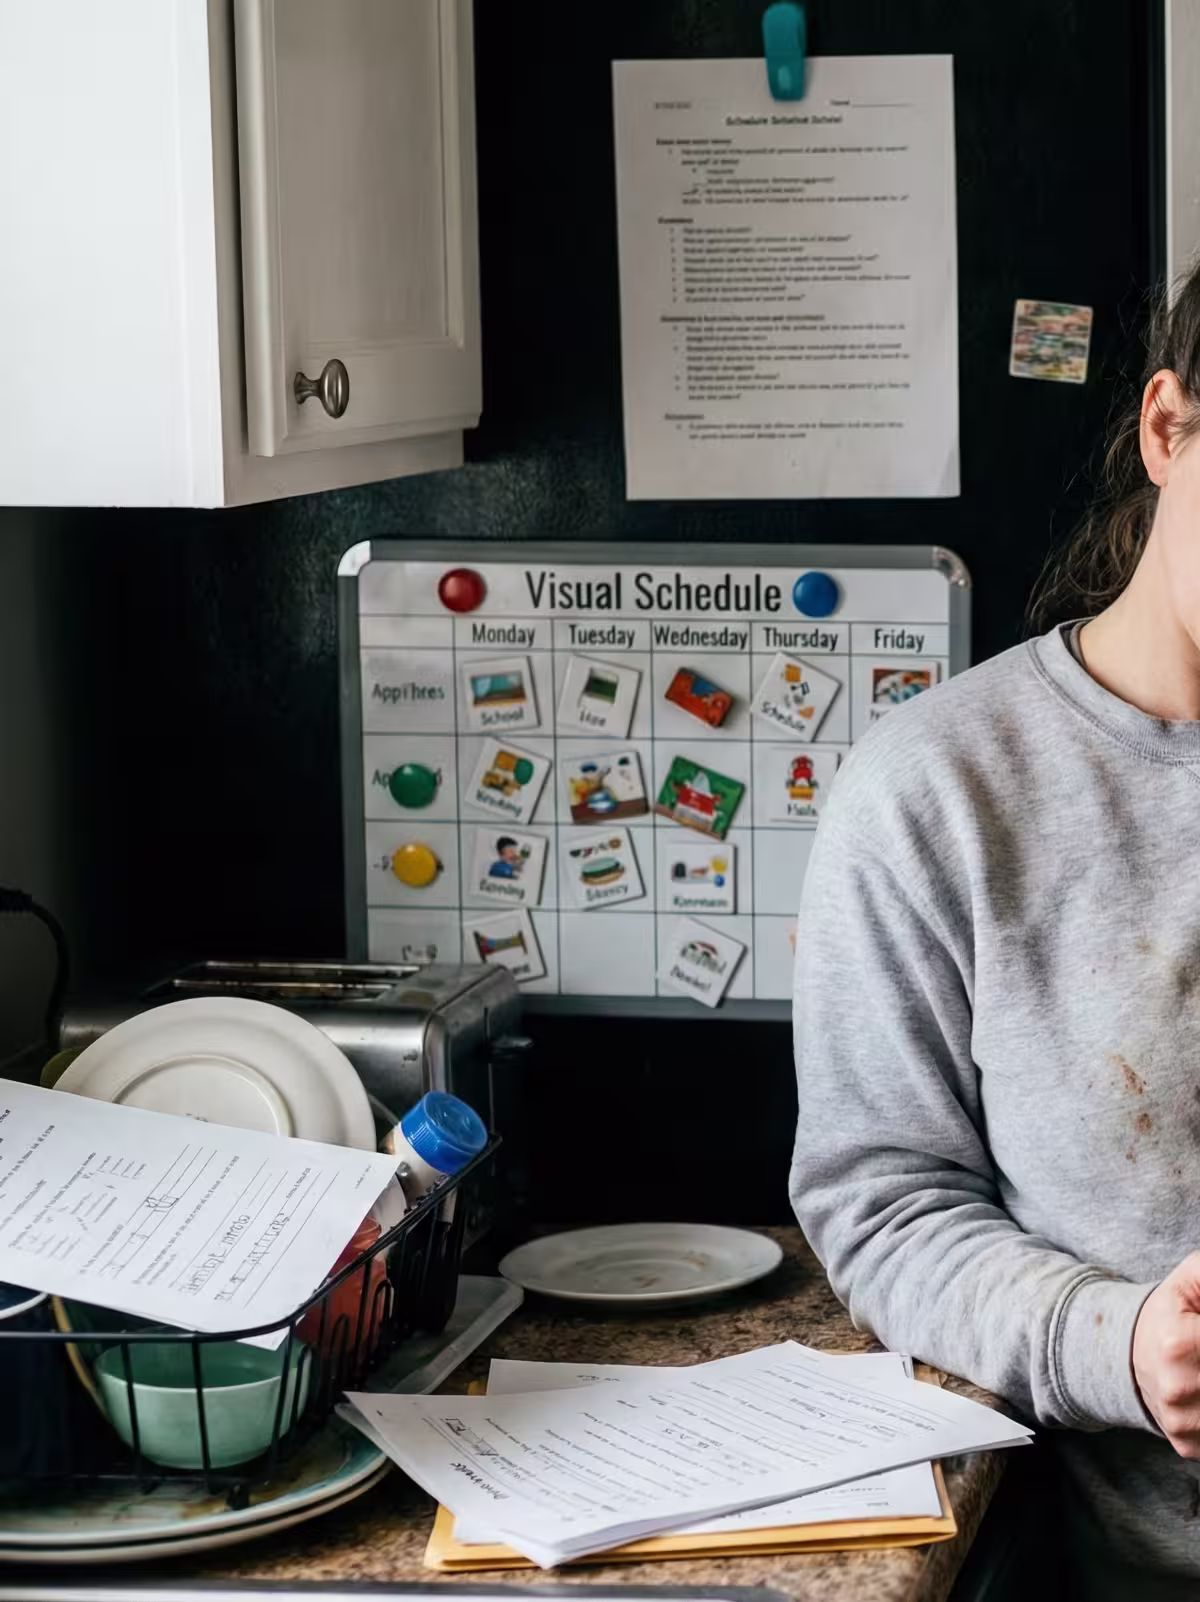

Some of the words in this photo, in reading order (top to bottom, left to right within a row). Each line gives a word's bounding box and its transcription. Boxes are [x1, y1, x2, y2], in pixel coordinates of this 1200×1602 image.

[525, 571, 621, 610] Visual
[635, 572, 781, 612] Schedule
[472, 623, 535, 647] Monday
[569, 624, 636, 649] Tuesday
[654, 626, 749, 651] Wednesday
[763, 627, 839, 652] Thursday
[874, 629, 925, 653] Friday
[481, 708, 524, 725] School
[761, 701, 805, 731] Schedule
